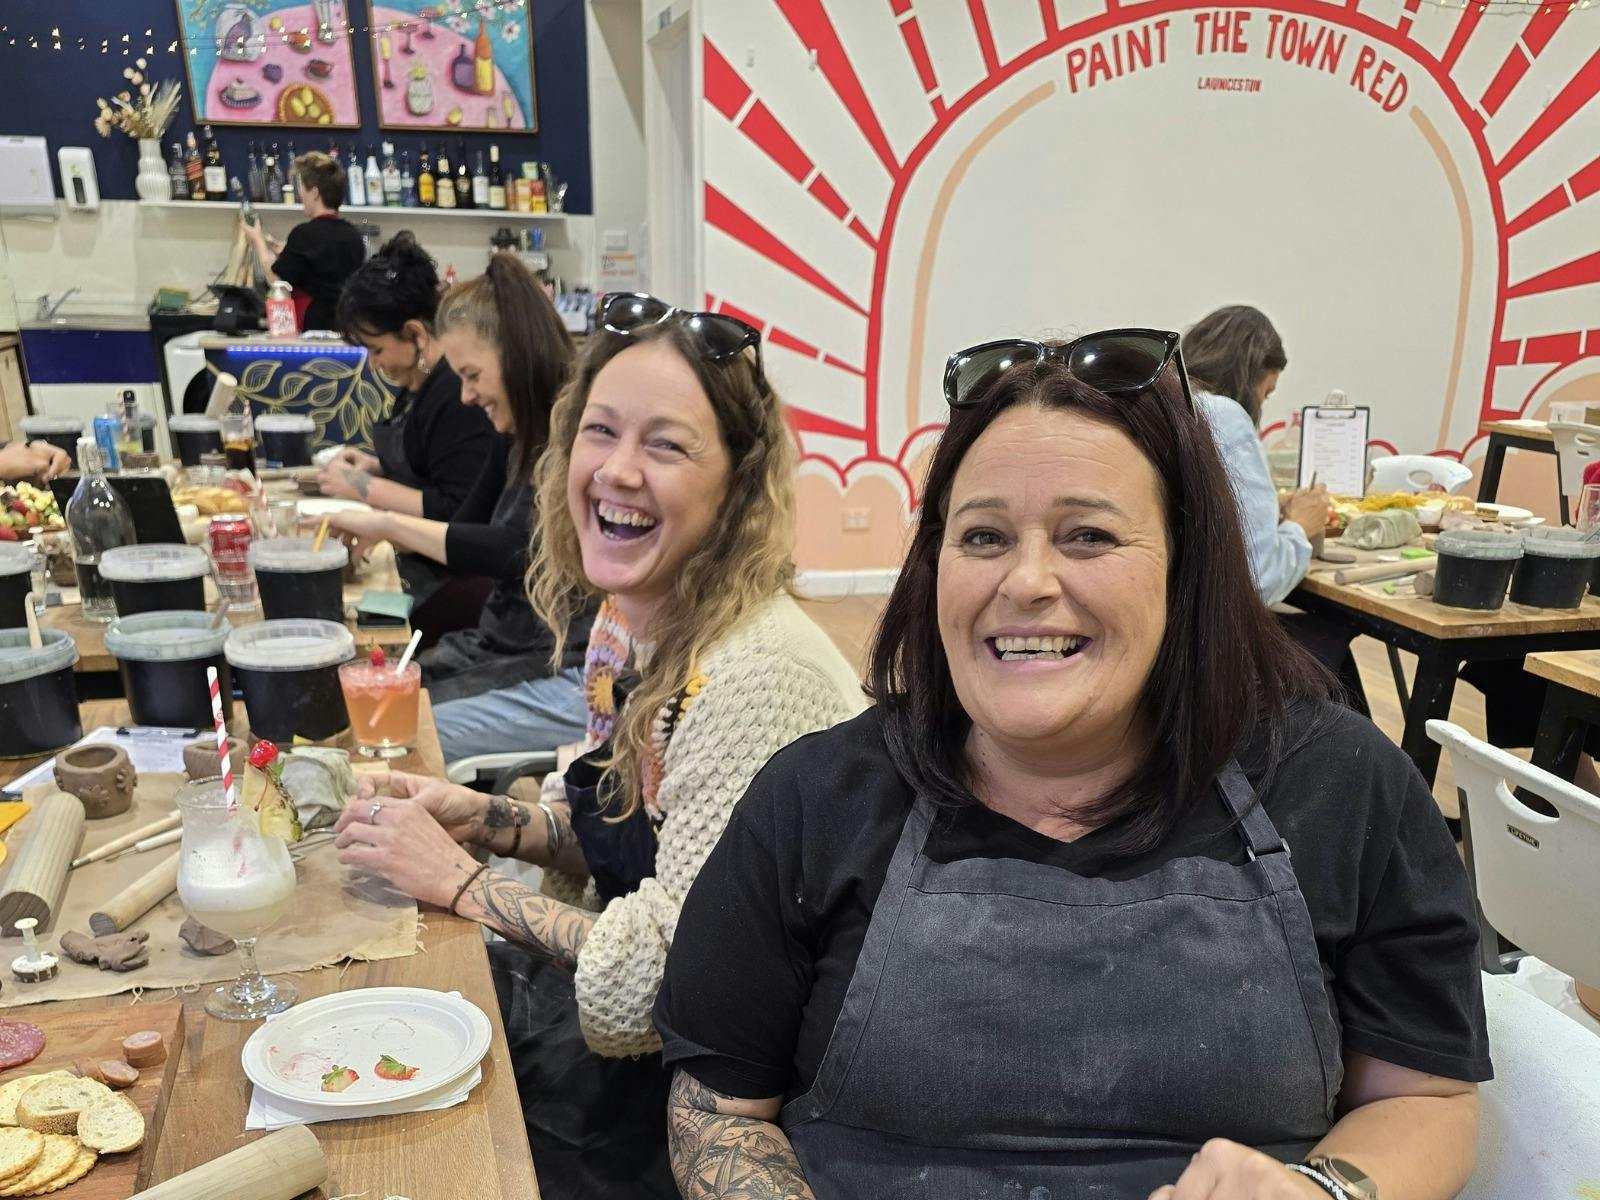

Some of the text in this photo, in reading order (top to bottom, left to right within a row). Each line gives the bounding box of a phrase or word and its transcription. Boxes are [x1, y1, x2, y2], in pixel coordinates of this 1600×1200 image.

[1066, 11, 1408, 113] PAINT THE TOWN RED
[1198, 77, 1262, 92] LAUNCESTON
